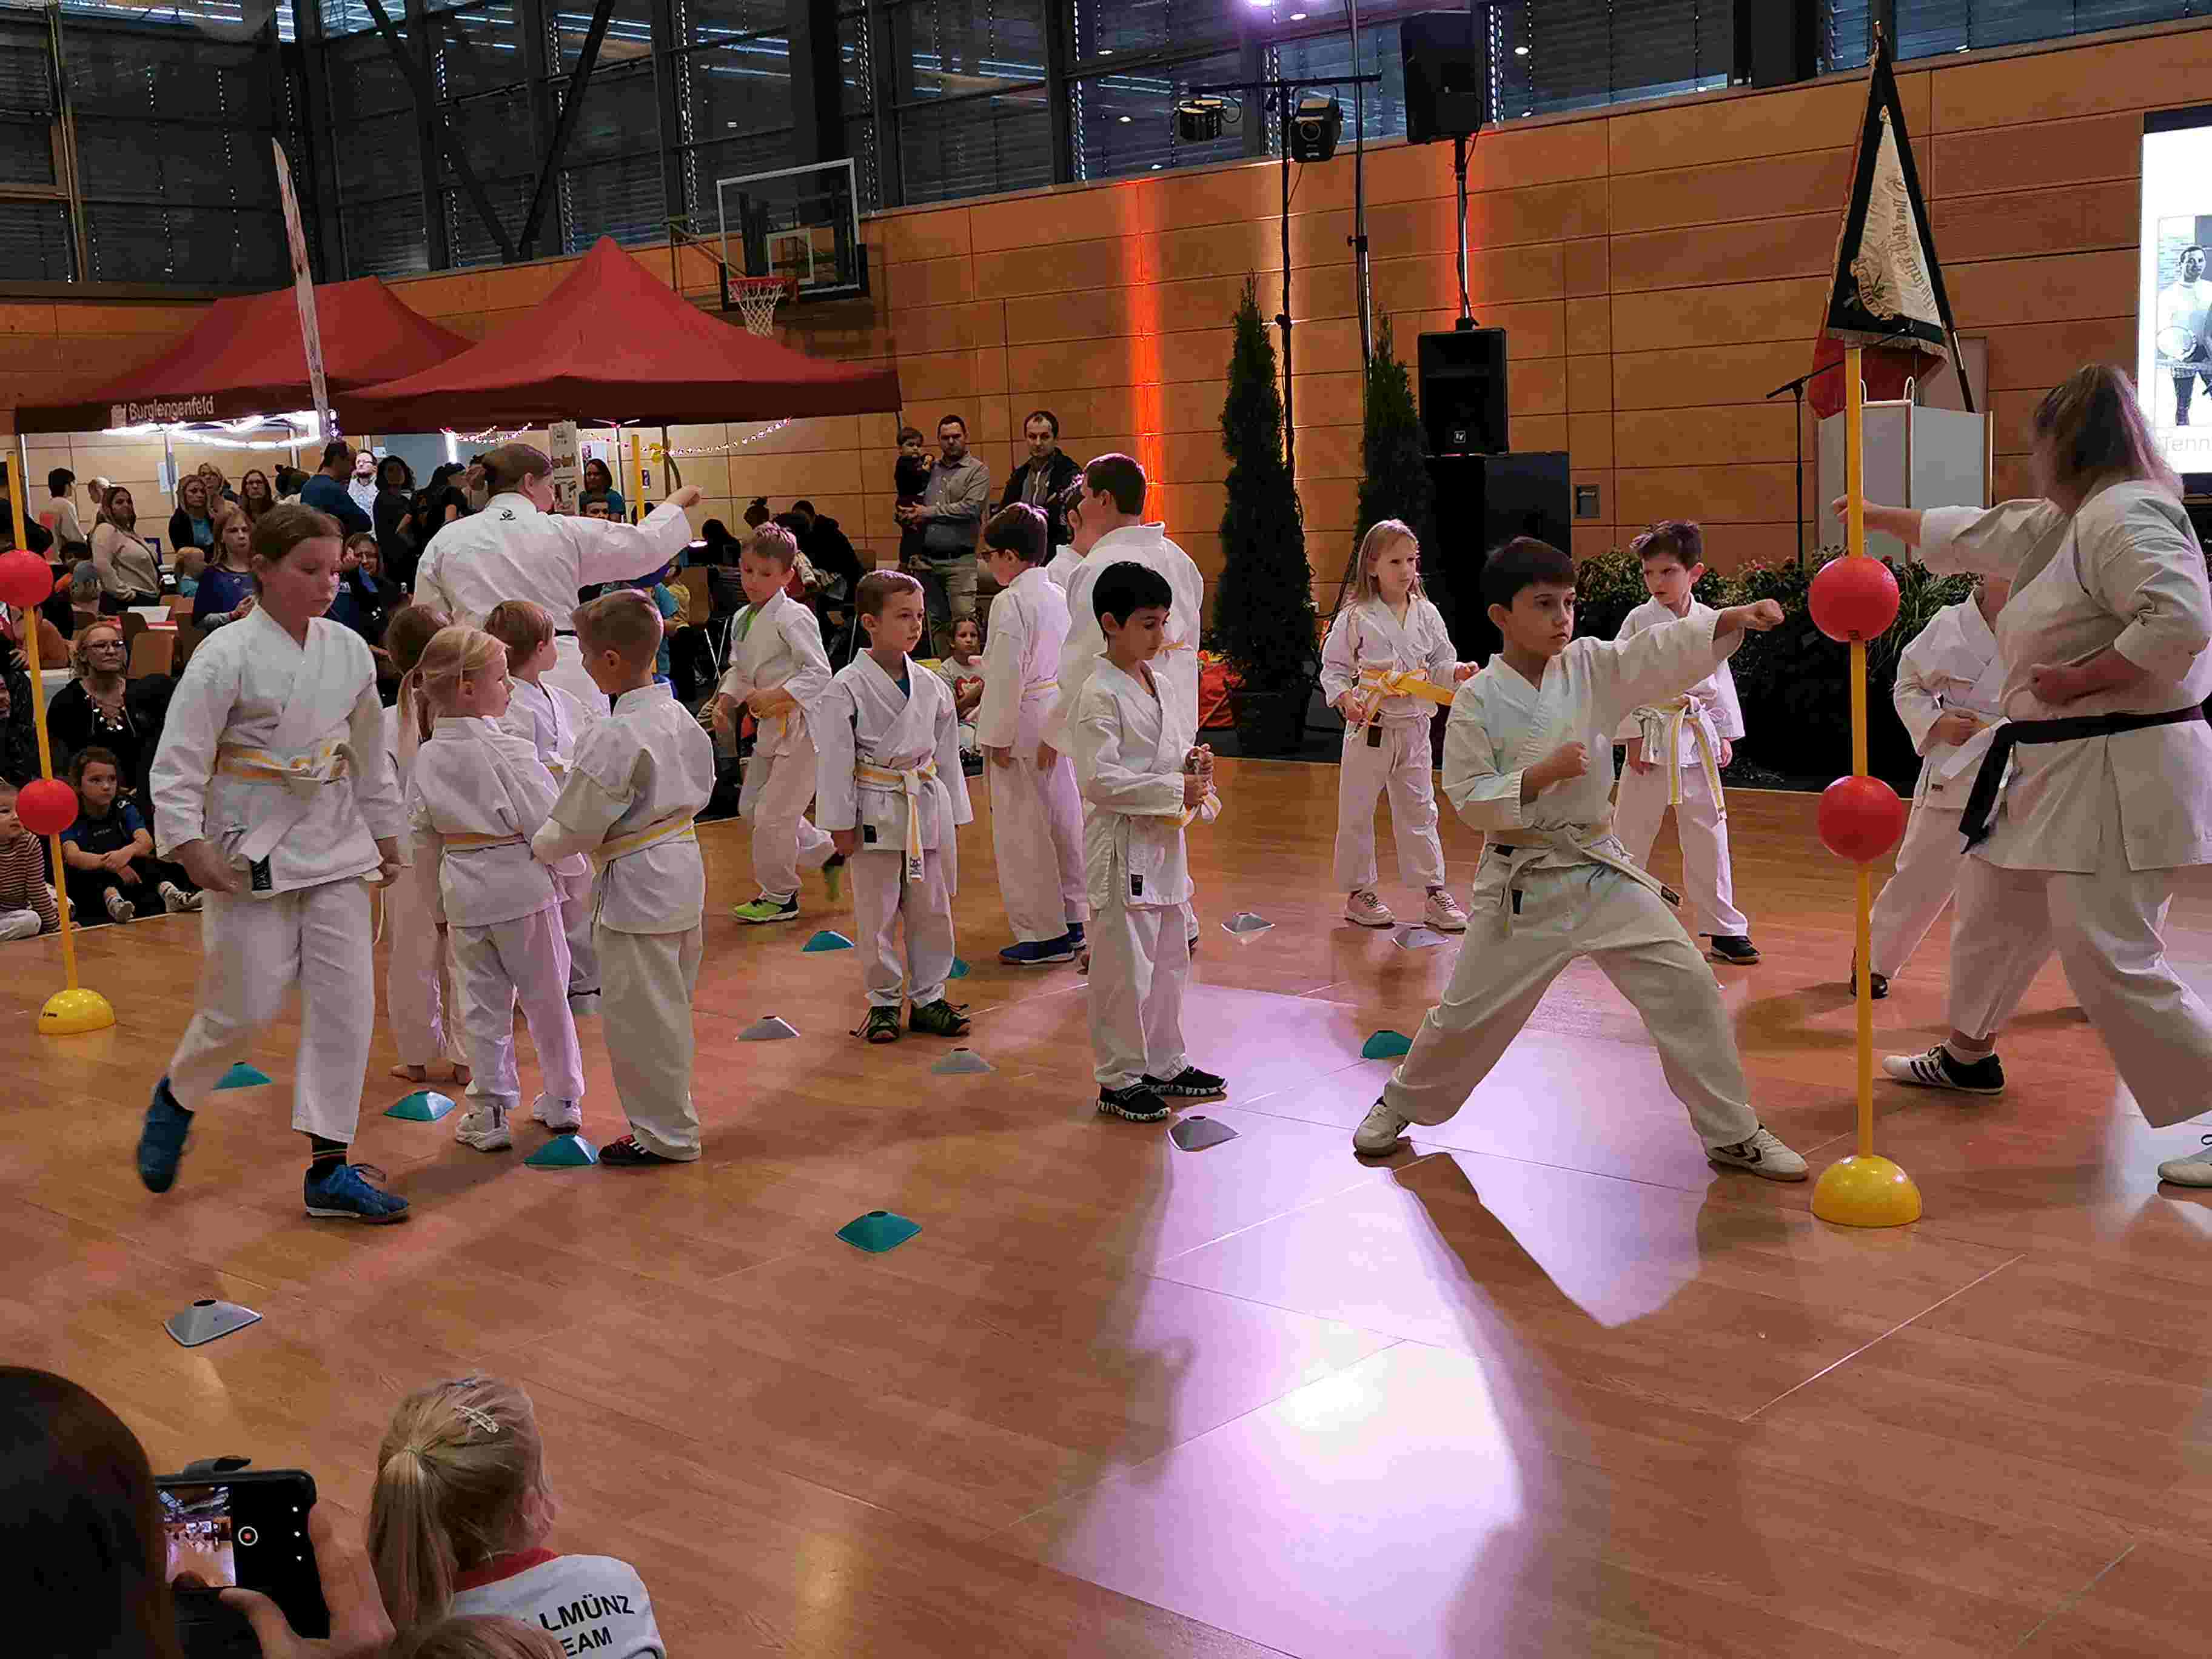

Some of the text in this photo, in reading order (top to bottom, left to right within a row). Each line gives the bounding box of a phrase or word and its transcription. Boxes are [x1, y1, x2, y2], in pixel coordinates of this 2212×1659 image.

[129, 395, 213, 422] Burglengenfeld
[539, 1594, 635, 1631] LMÜNZ
[559, 1626, 613, 1657] EAM
